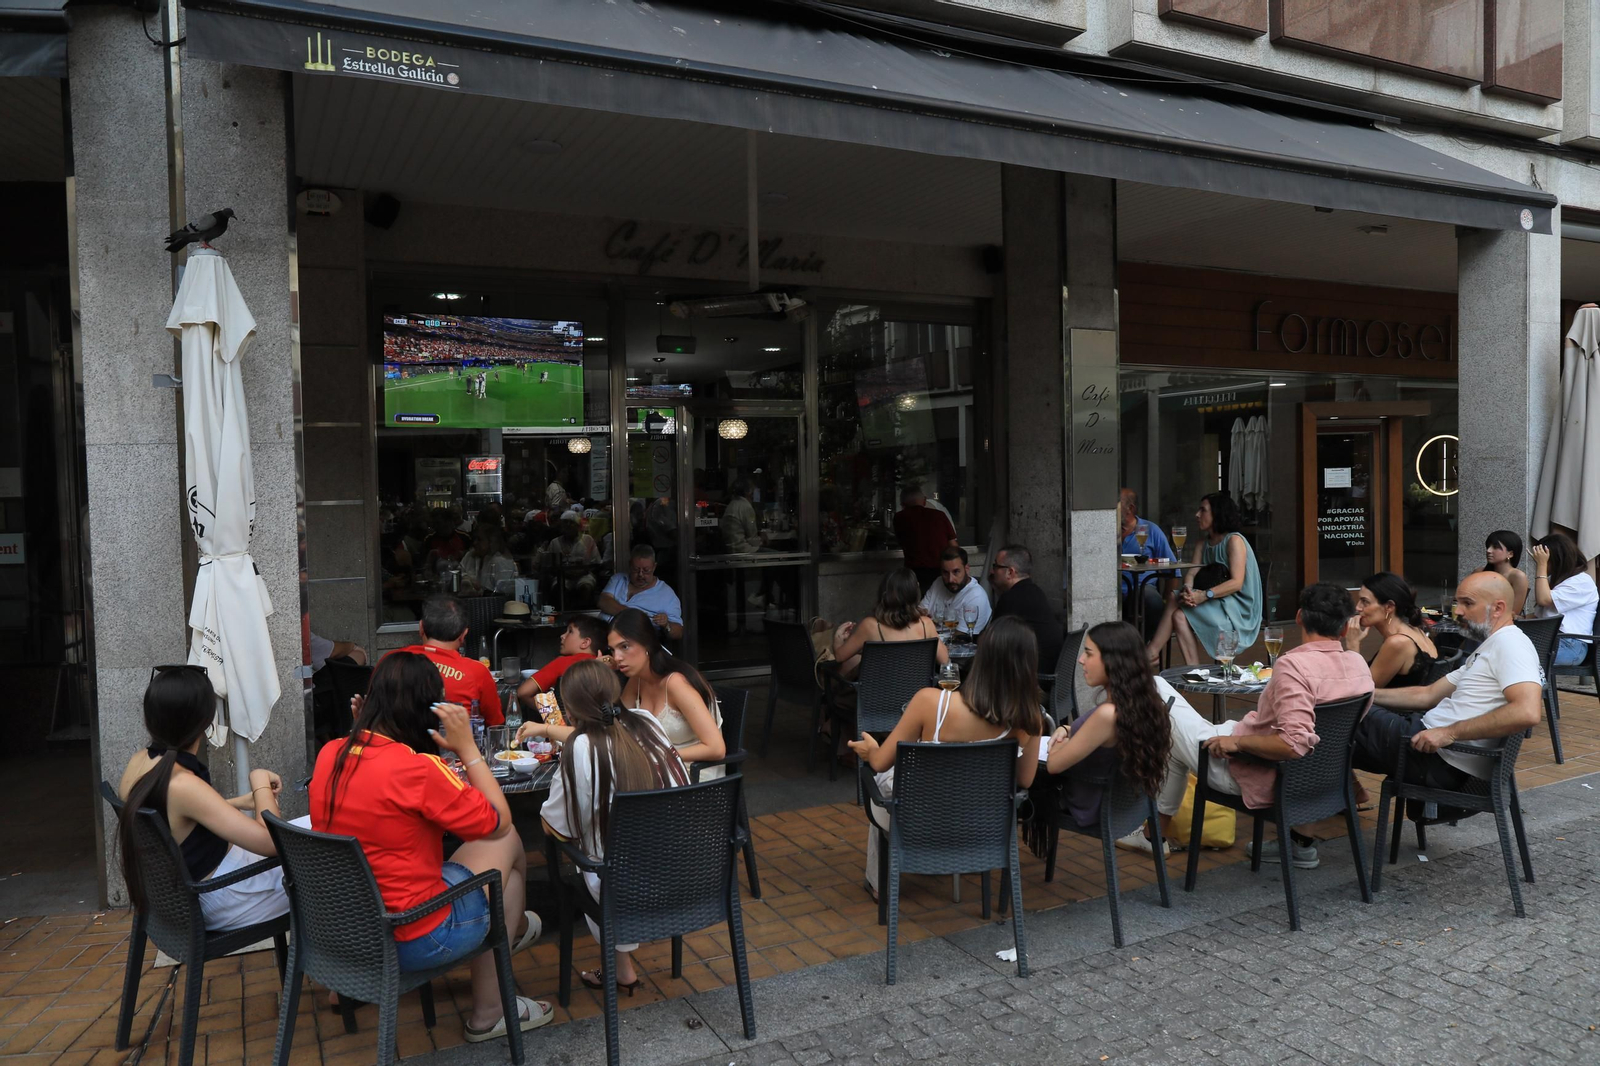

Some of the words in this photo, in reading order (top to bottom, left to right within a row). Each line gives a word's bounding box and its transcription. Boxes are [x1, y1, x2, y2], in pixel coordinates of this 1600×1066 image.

[366, 46, 437, 67] BODEGA
[342, 56, 395, 76] Estrella
[397, 65, 444, 83] Galicia
